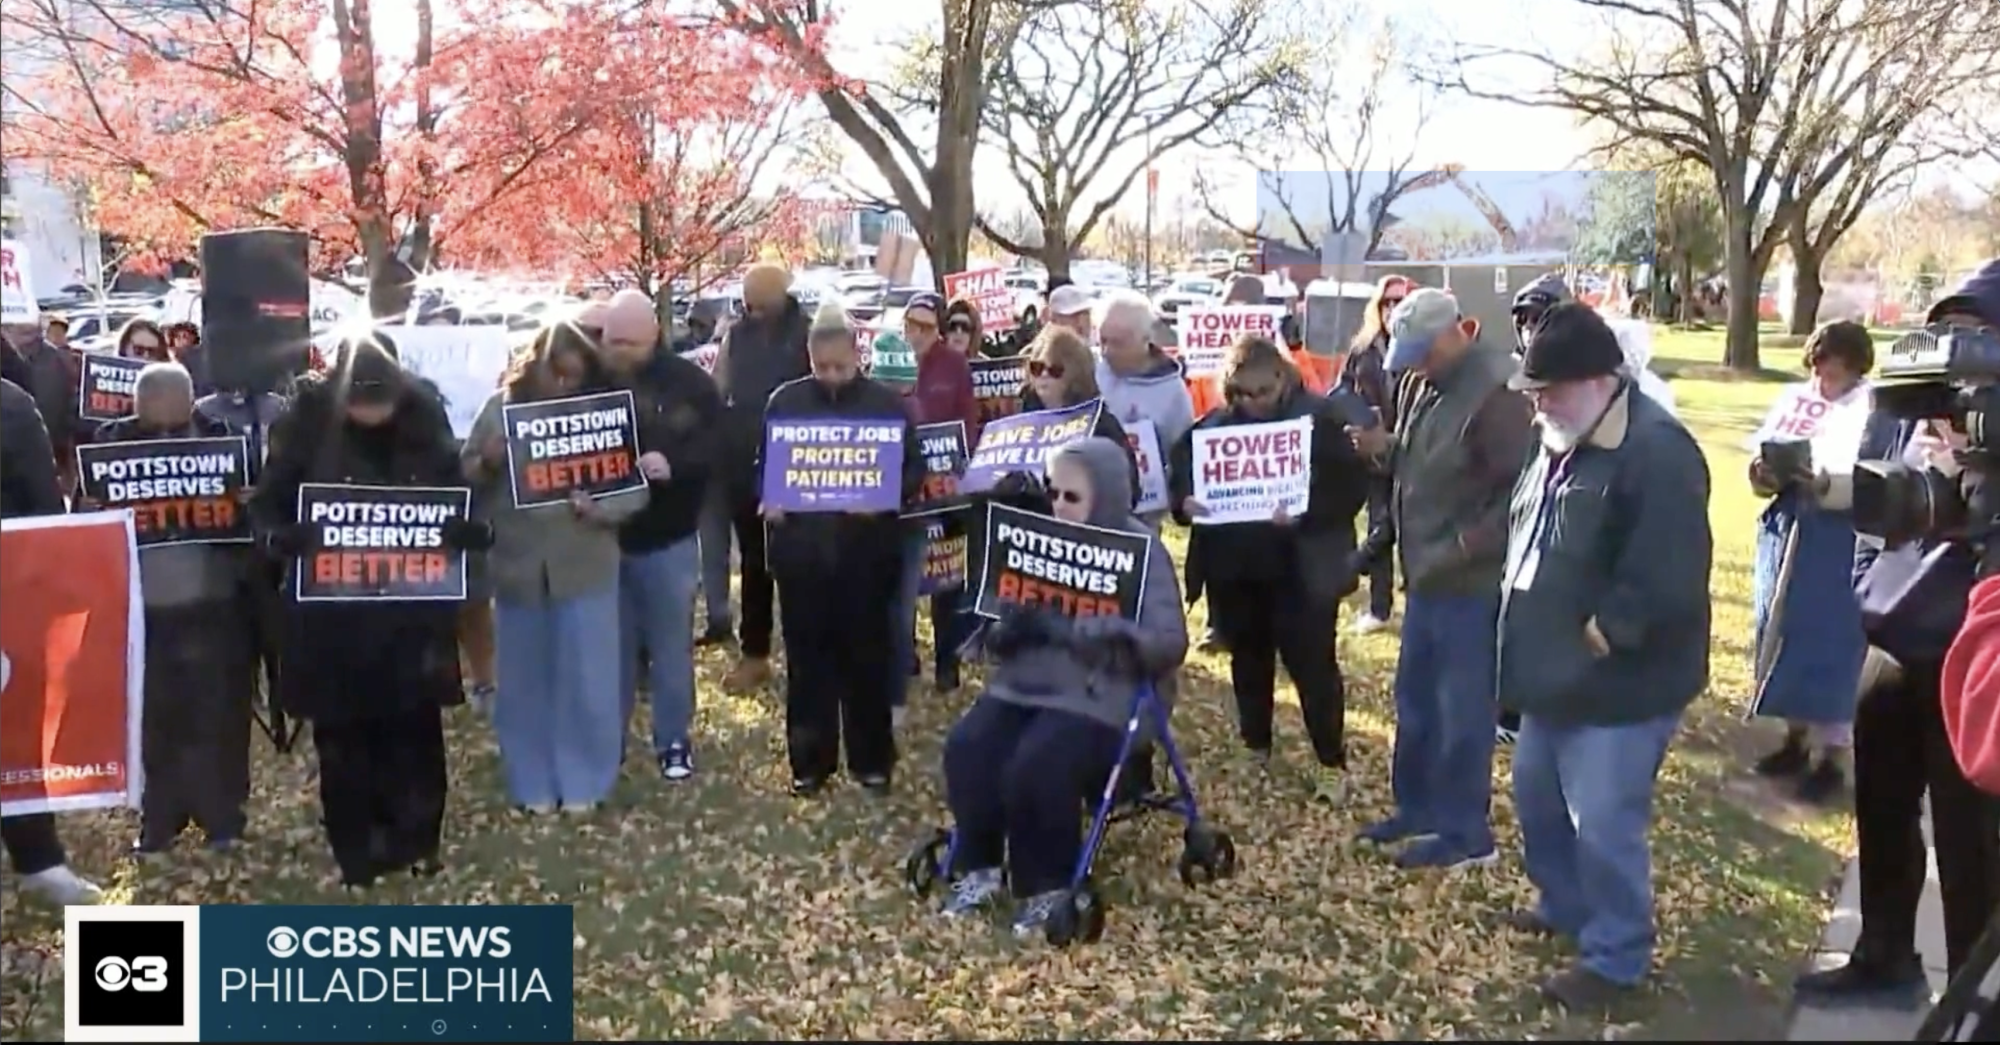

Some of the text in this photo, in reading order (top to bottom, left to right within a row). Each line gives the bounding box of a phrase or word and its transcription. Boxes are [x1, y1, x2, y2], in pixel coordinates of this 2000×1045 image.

[1190, 313, 1273, 331] TOWER
[971, 367, 1026, 384] STOWN
[515, 407, 628, 441] POTTSTOWN
[771, 426, 903, 443] PROTECT JOBS
[978, 424, 1036, 451] SAVE
[1037, 414, 1089, 444] JOBS
[530, 429, 623, 460] DESERVES
[791, 447, 879, 465] PROTECT
[1205, 429, 1302, 461] TOWER
[92, 455, 235, 481] POTTSTOWN
[524, 451, 631, 493] BETTER
[786, 469, 882, 489] PATIENTS!
[1203, 452, 1303, 485] HEALTH
[108, 477, 226, 502] DESERVES
[132, 500, 236, 532] ETTER
[310, 502, 456, 523] POTTSTOWN
[323, 525, 442, 549] DESERVES
[997, 522, 1136, 573] POTTSTOWN
[315, 551, 450, 584] BETTER
[1006, 548, 1119, 596] DESERVES
